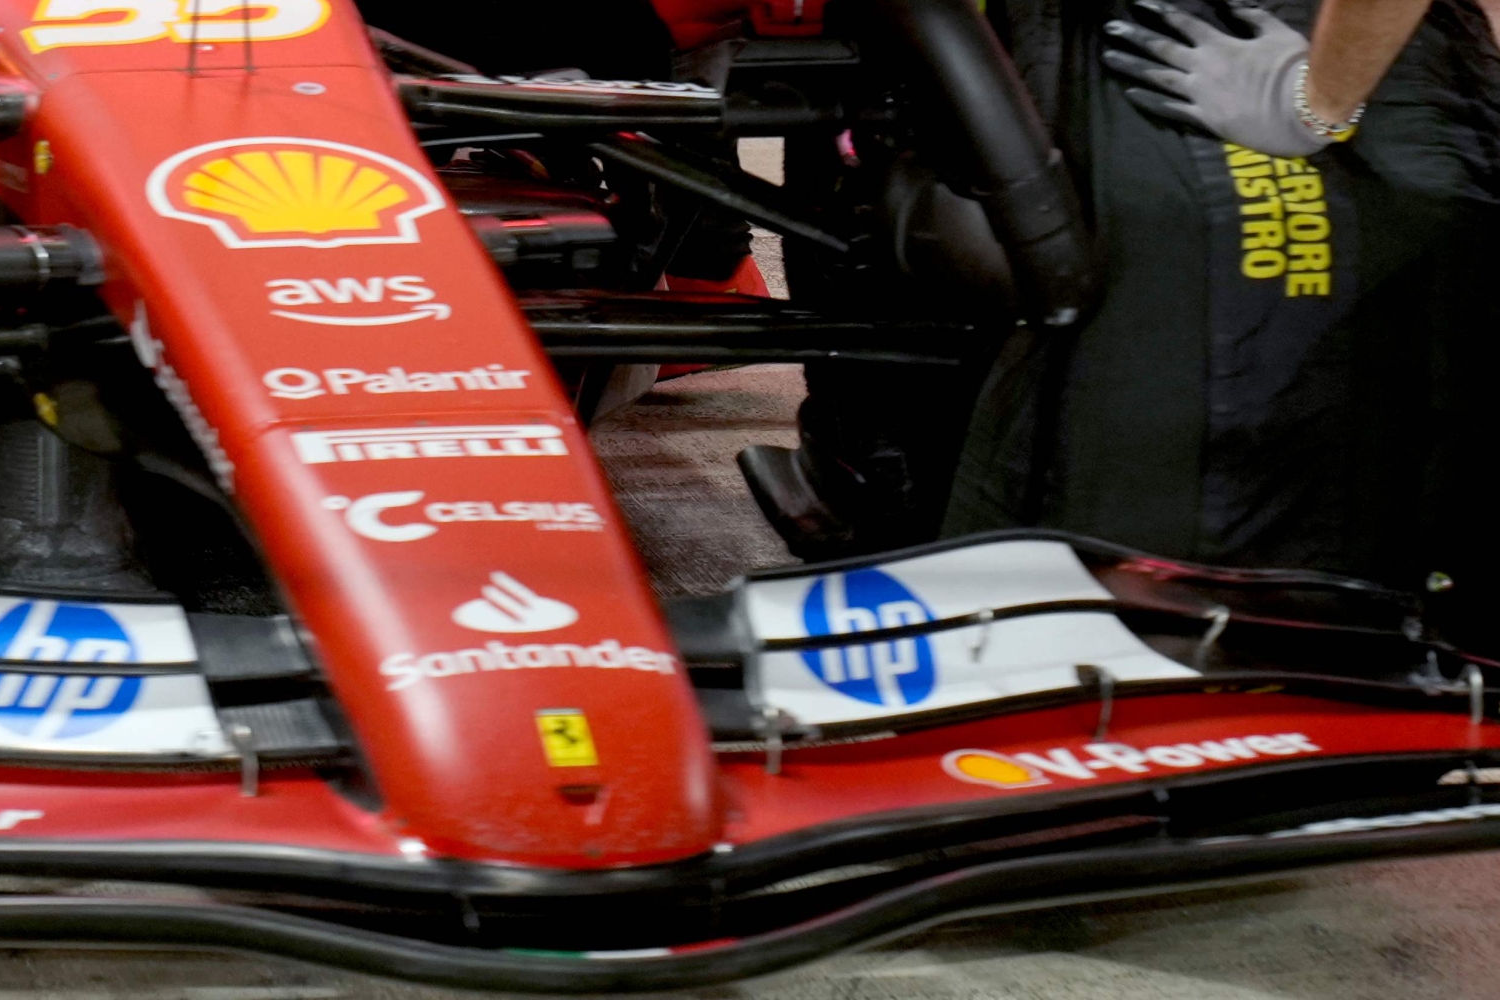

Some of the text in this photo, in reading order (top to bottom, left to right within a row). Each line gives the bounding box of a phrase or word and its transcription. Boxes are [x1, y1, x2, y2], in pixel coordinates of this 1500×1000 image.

[1222, 143, 1288, 281] NISTRO
[1273, 157, 1334, 298] ERIORE
[265, 275, 436, 306] aws
[324, 363, 531, 396] Palantir
[291, 425, 570, 463] PIRELLI
[424, 501, 602, 524] CELSIUS
[825, 569, 922, 706] hp
[380, 641, 678, 692] Santander
[1020, 730, 1323, 780] V-Power
